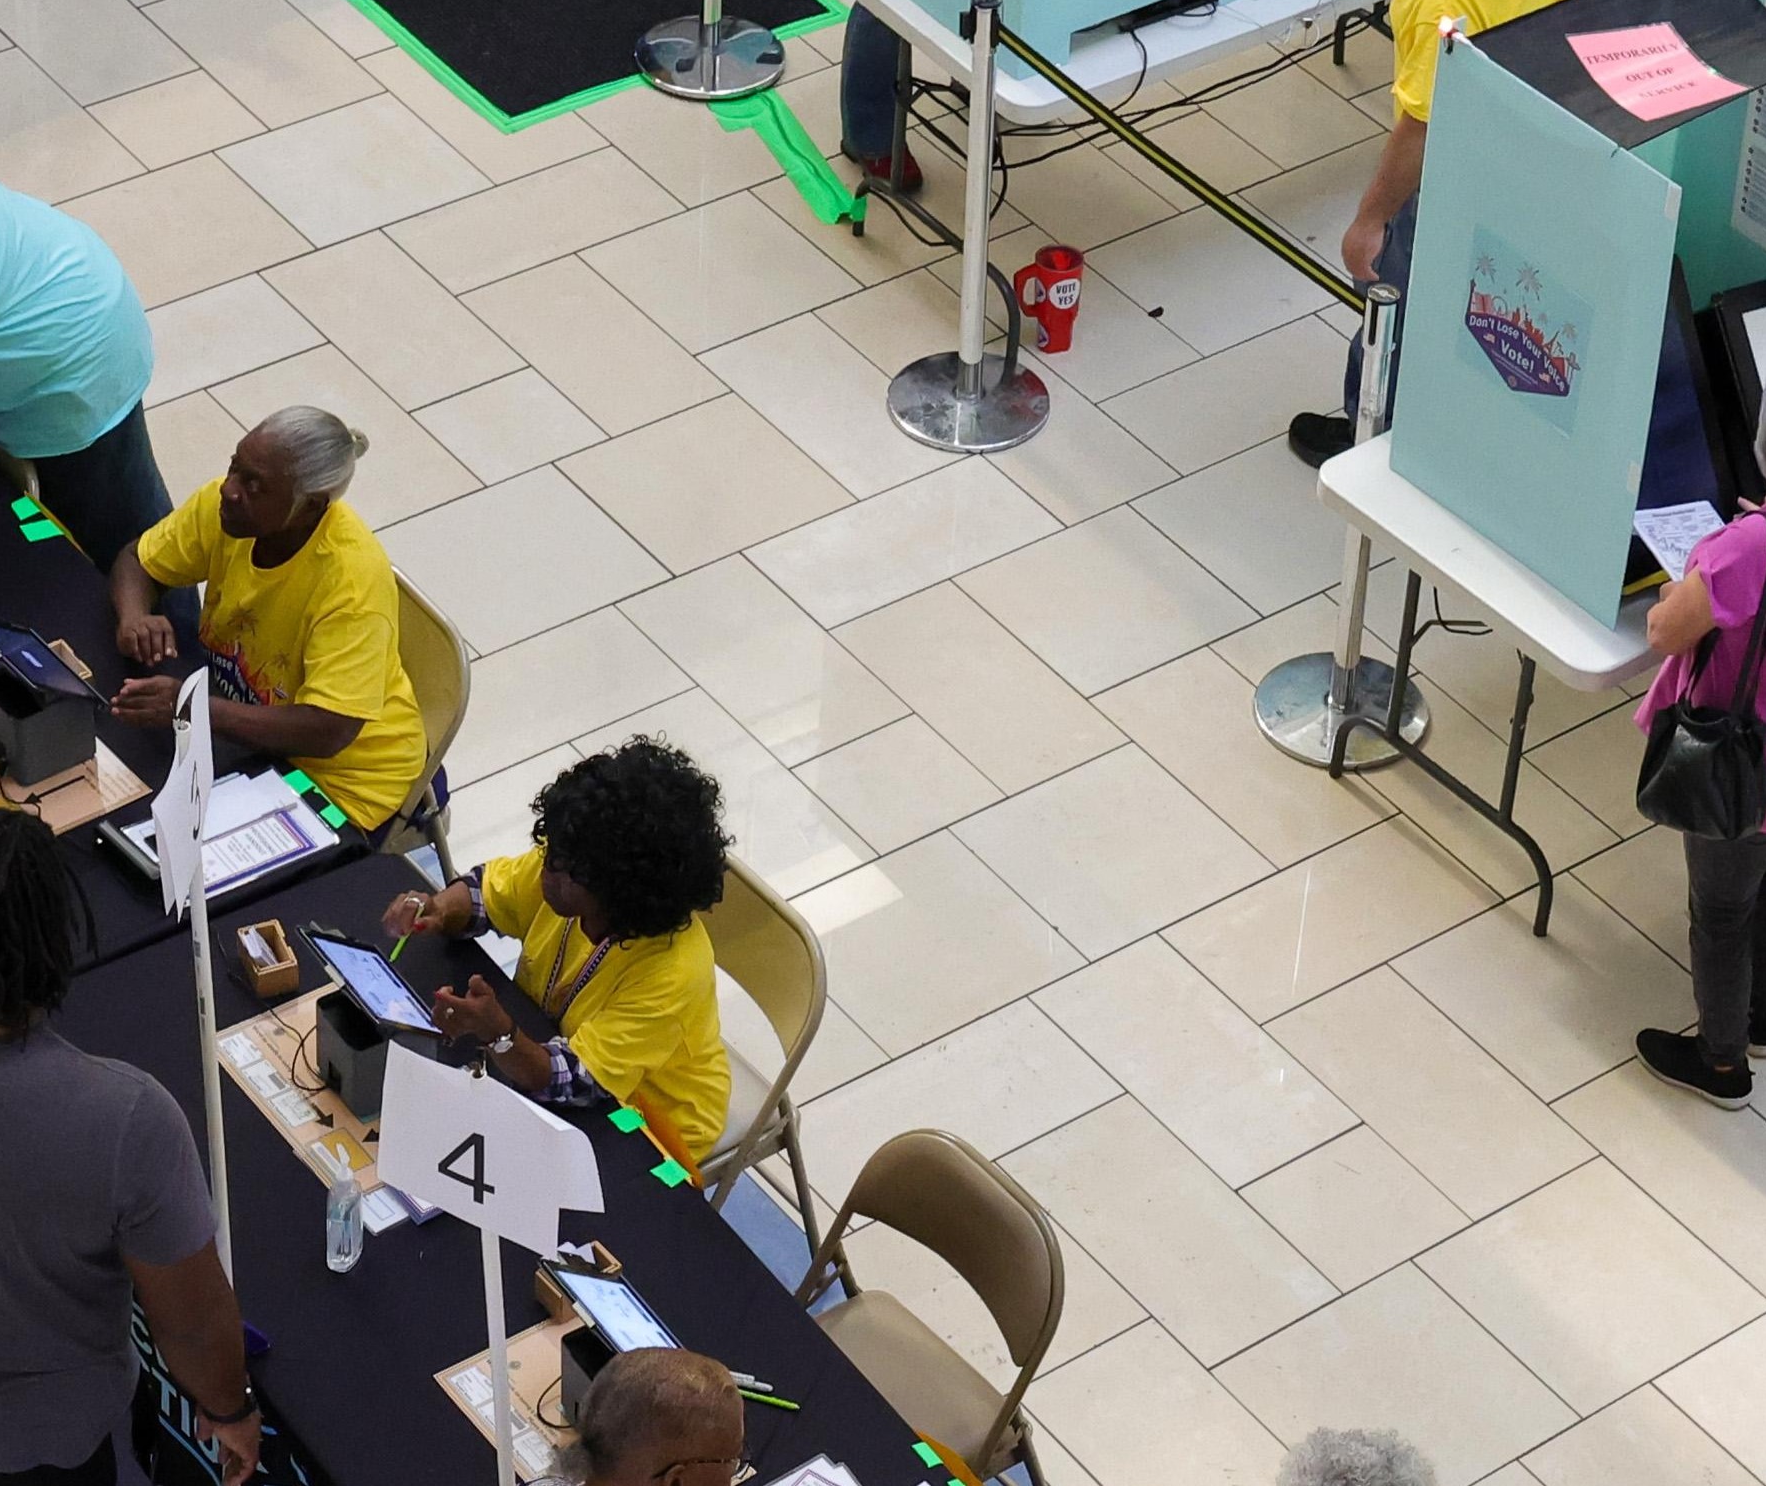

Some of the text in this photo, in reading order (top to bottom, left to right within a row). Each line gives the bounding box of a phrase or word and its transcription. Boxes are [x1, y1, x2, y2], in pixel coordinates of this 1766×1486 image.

[1583, 43, 1680, 65] TEMPORARILY
[1625, 70, 1655, 82] OUT
[1469, 315, 1495, 330] Don't
[1497, 320, 1520, 340] Lose
[1521, 332, 1543, 359] Your
[1543, 356, 1565, 392] Voice
[1501, 339, 1535, 373] Vote!
[438, 1132, 495, 1204] 4
